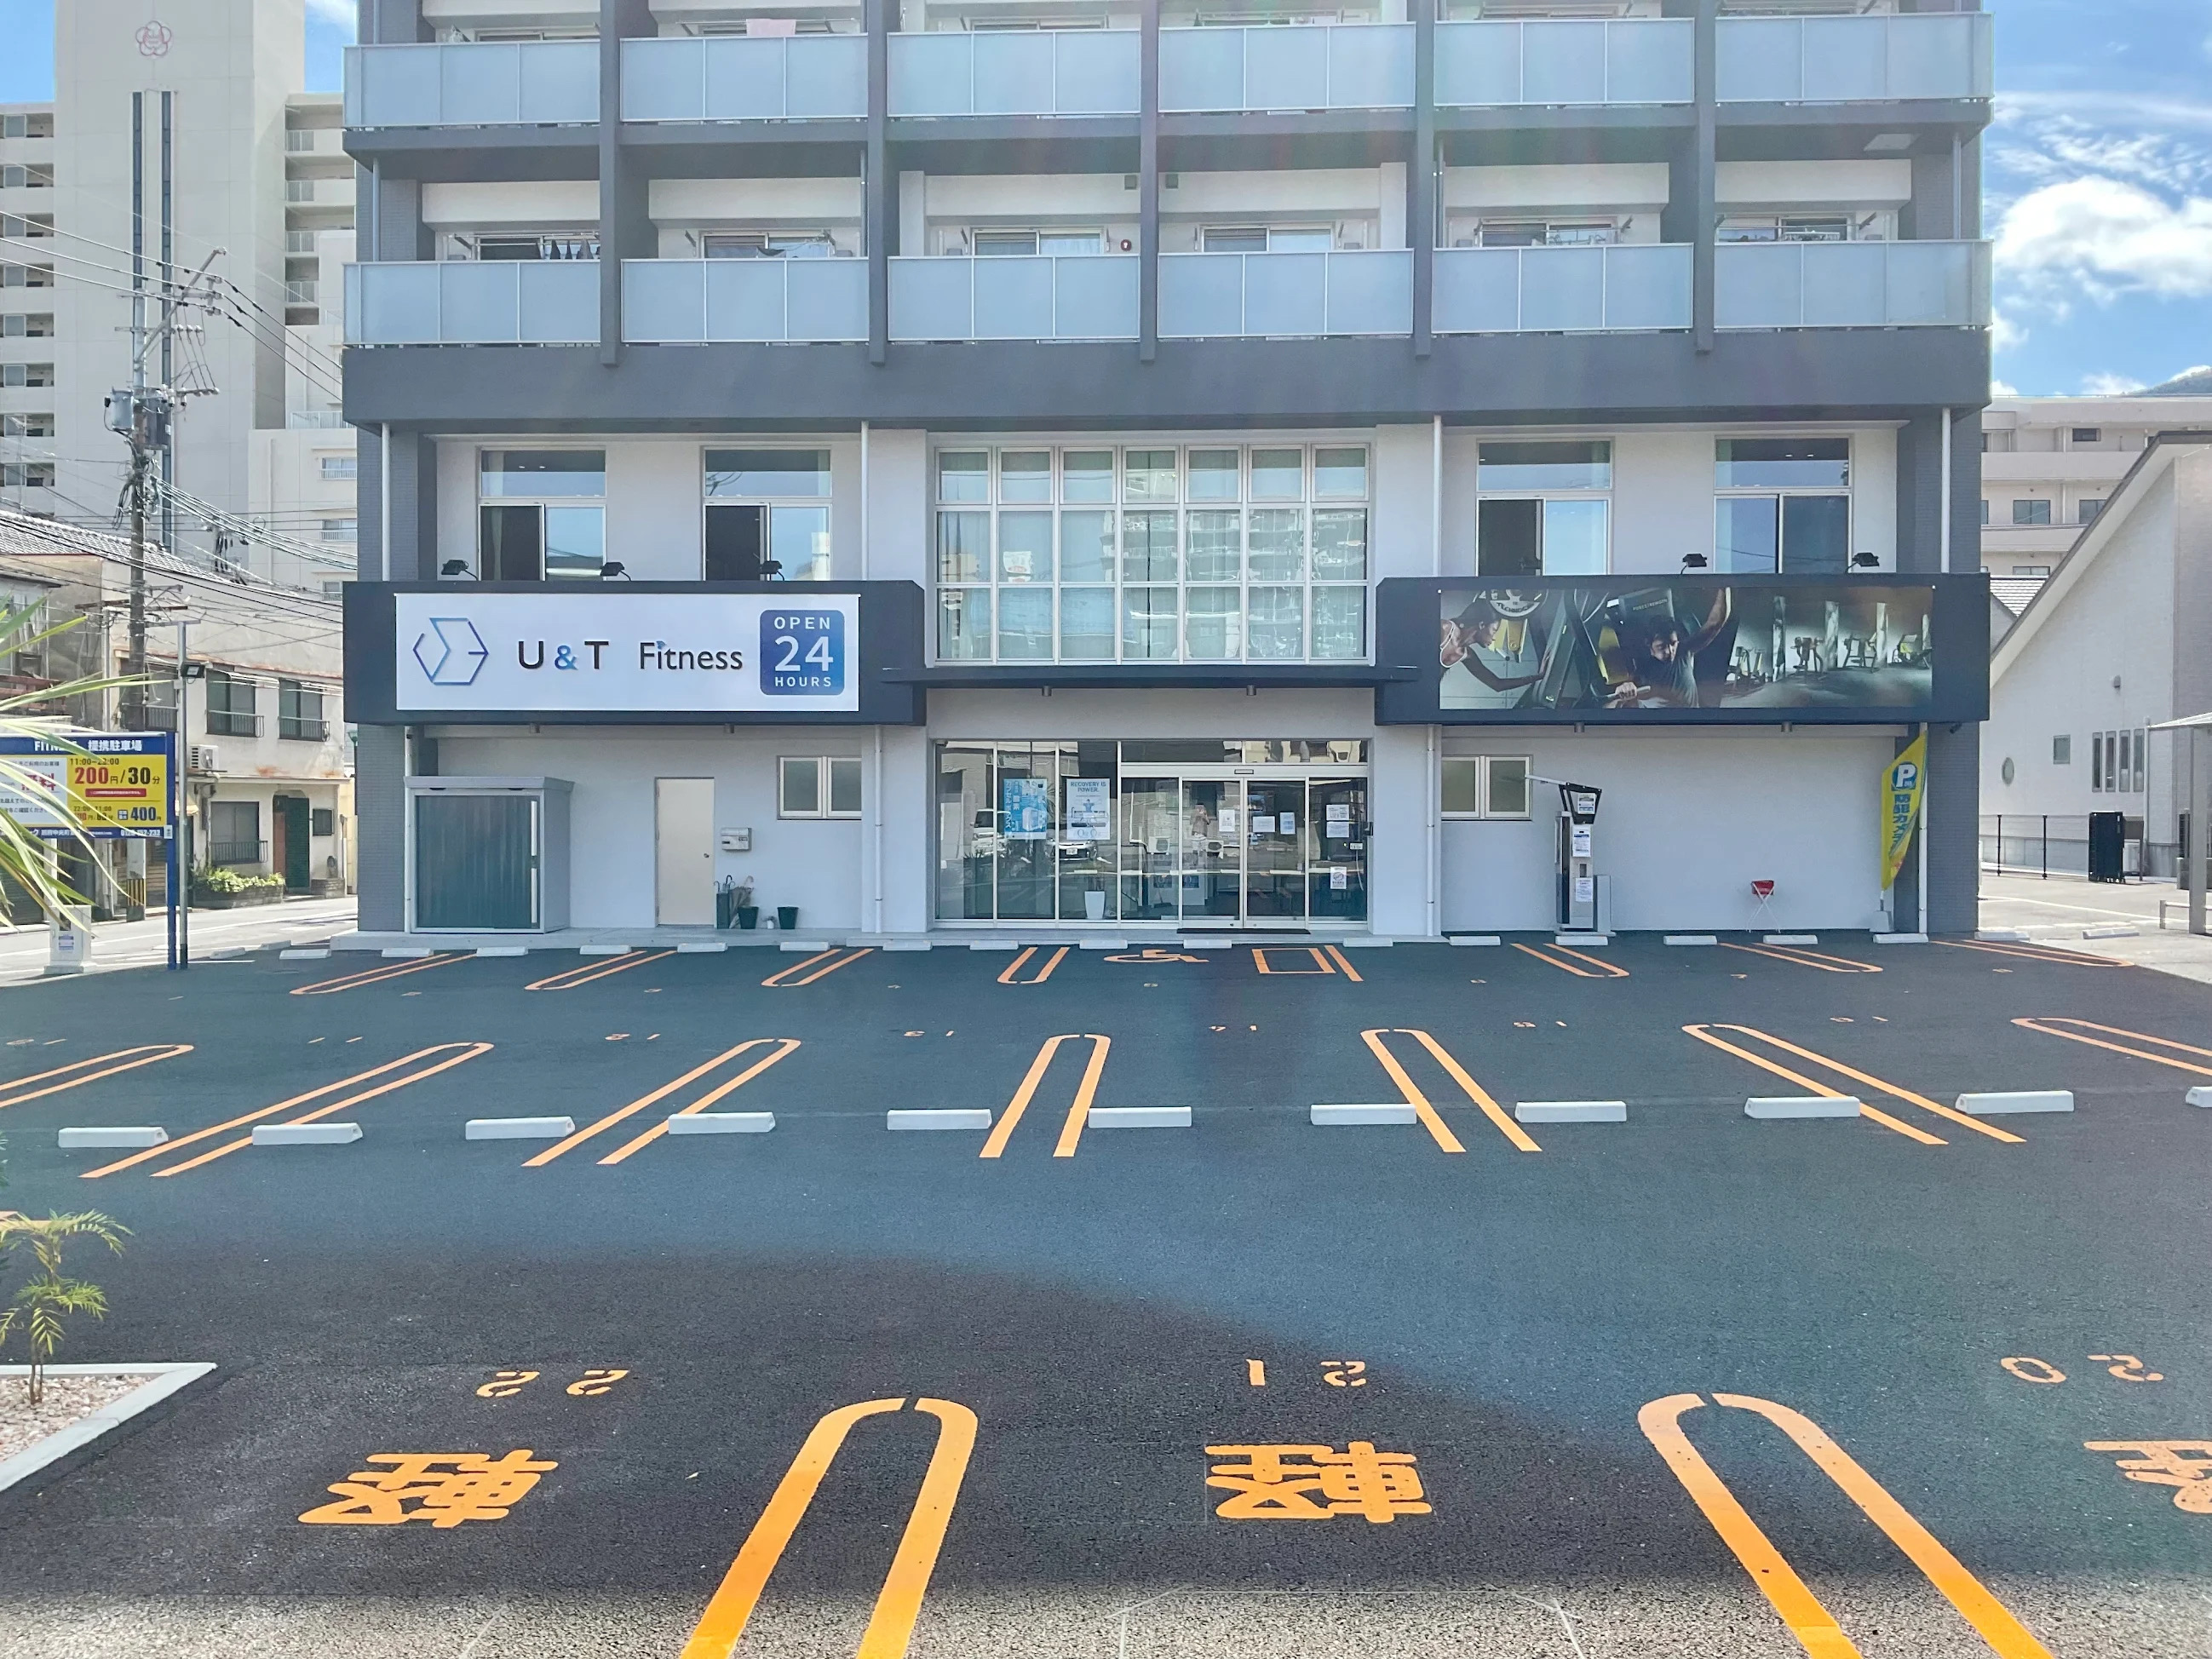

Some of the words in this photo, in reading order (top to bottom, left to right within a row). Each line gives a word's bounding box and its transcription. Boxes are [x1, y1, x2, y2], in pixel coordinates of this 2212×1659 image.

[773, 616, 830, 629] OPEN
[640, 640, 743, 670] Fitness
[774, 634, 834, 672] 24
[774, 676, 832, 687] HOURS
